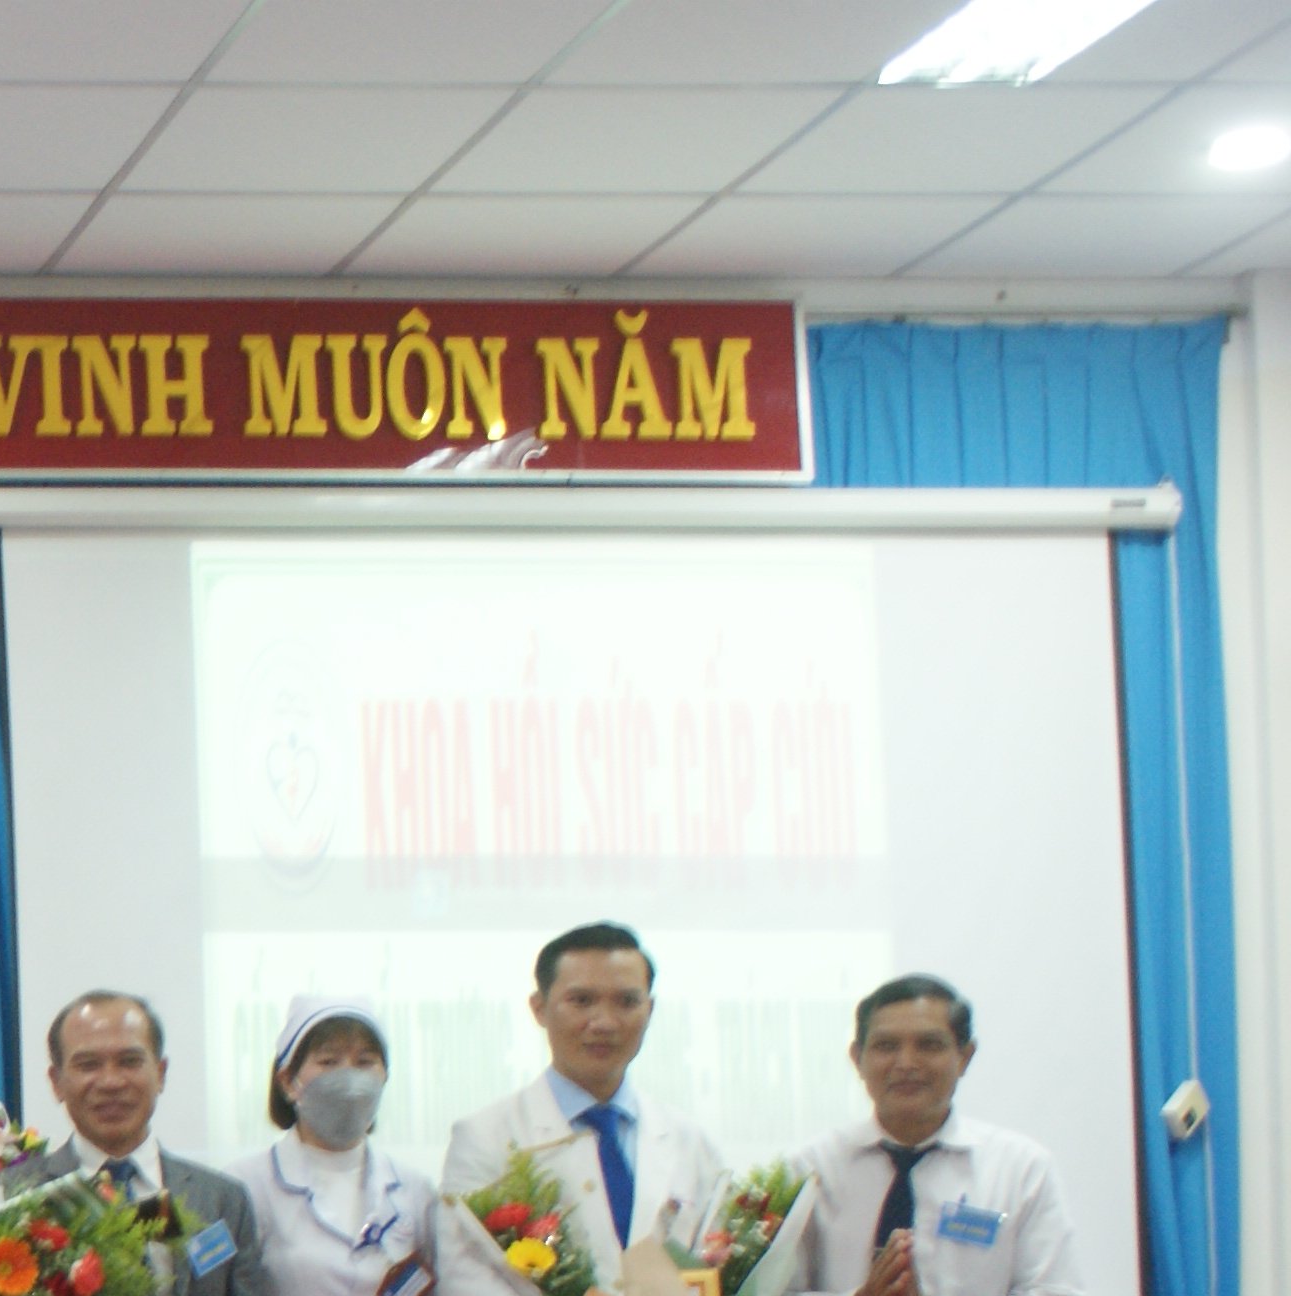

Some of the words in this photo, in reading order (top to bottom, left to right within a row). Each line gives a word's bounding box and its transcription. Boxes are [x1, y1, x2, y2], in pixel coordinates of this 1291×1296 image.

[241, 309, 506, 440] MUÔN
[536, 310, 755, 440] NĂM
[360, 698, 482, 892] KHOA
